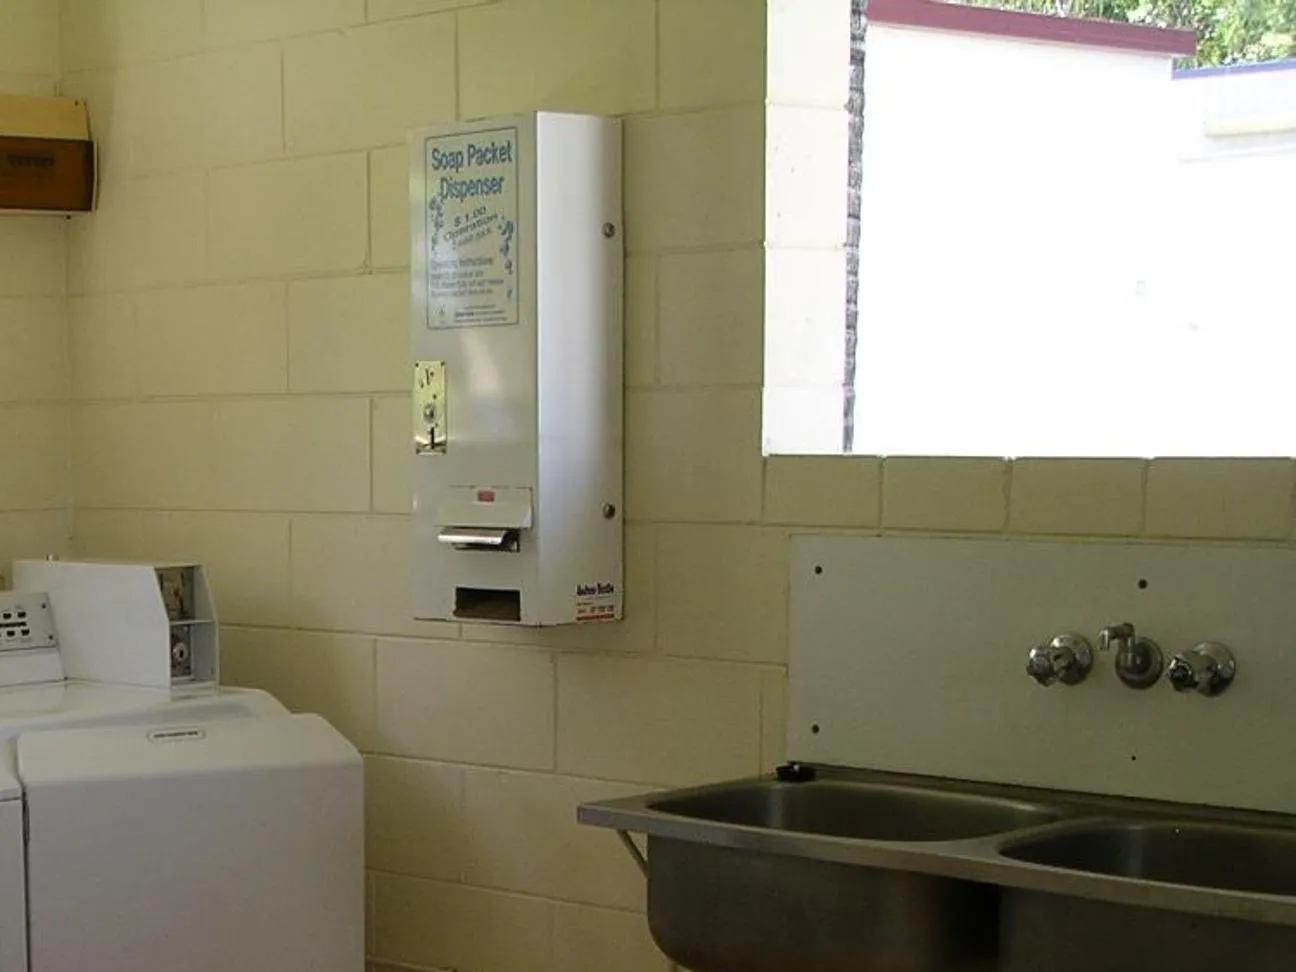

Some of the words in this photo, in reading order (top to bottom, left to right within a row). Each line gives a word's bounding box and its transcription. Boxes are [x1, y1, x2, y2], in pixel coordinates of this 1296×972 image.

[431, 148, 464, 173] Soap
[467, 140, 512, 166] Packet
[440, 176, 505, 203] Dispenser
